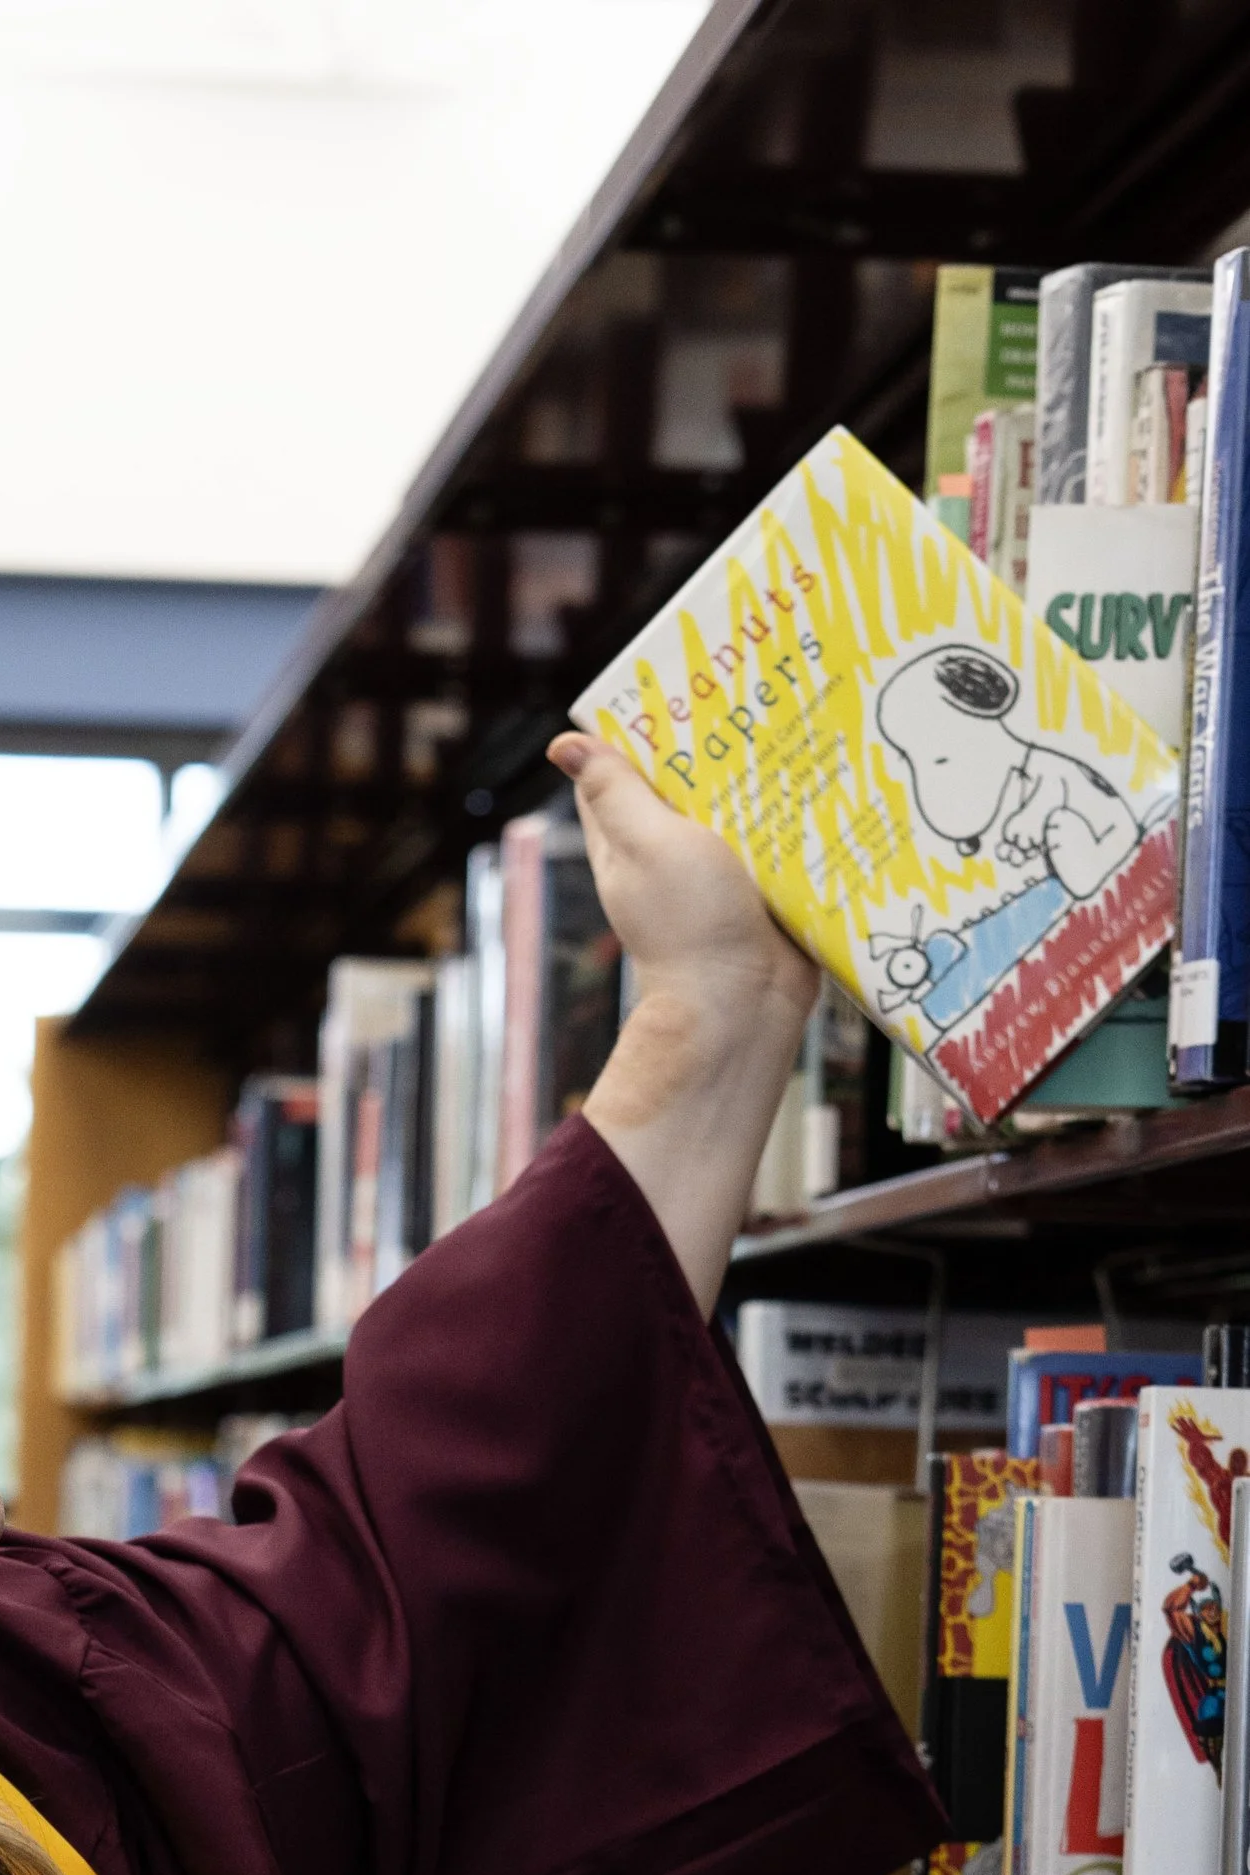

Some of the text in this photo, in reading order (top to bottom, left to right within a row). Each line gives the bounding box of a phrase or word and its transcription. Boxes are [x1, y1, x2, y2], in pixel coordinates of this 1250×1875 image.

[1196, 562, 1225, 636] The
[610, 673, 653, 715] The
[628, 562, 816, 752] Peanuts
[1194, 639, 1222, 718] War
[664, 630, 824, 790] Papers
[1187, 722, 1215, 828] Years
[1133, 1466, 1147, 1567] Origins
[1132, 1579, 1142, 1606] of
[1128, 1619, 1141, 1717] Marvel
[1124, 1729, 1136, 1830] Comics
